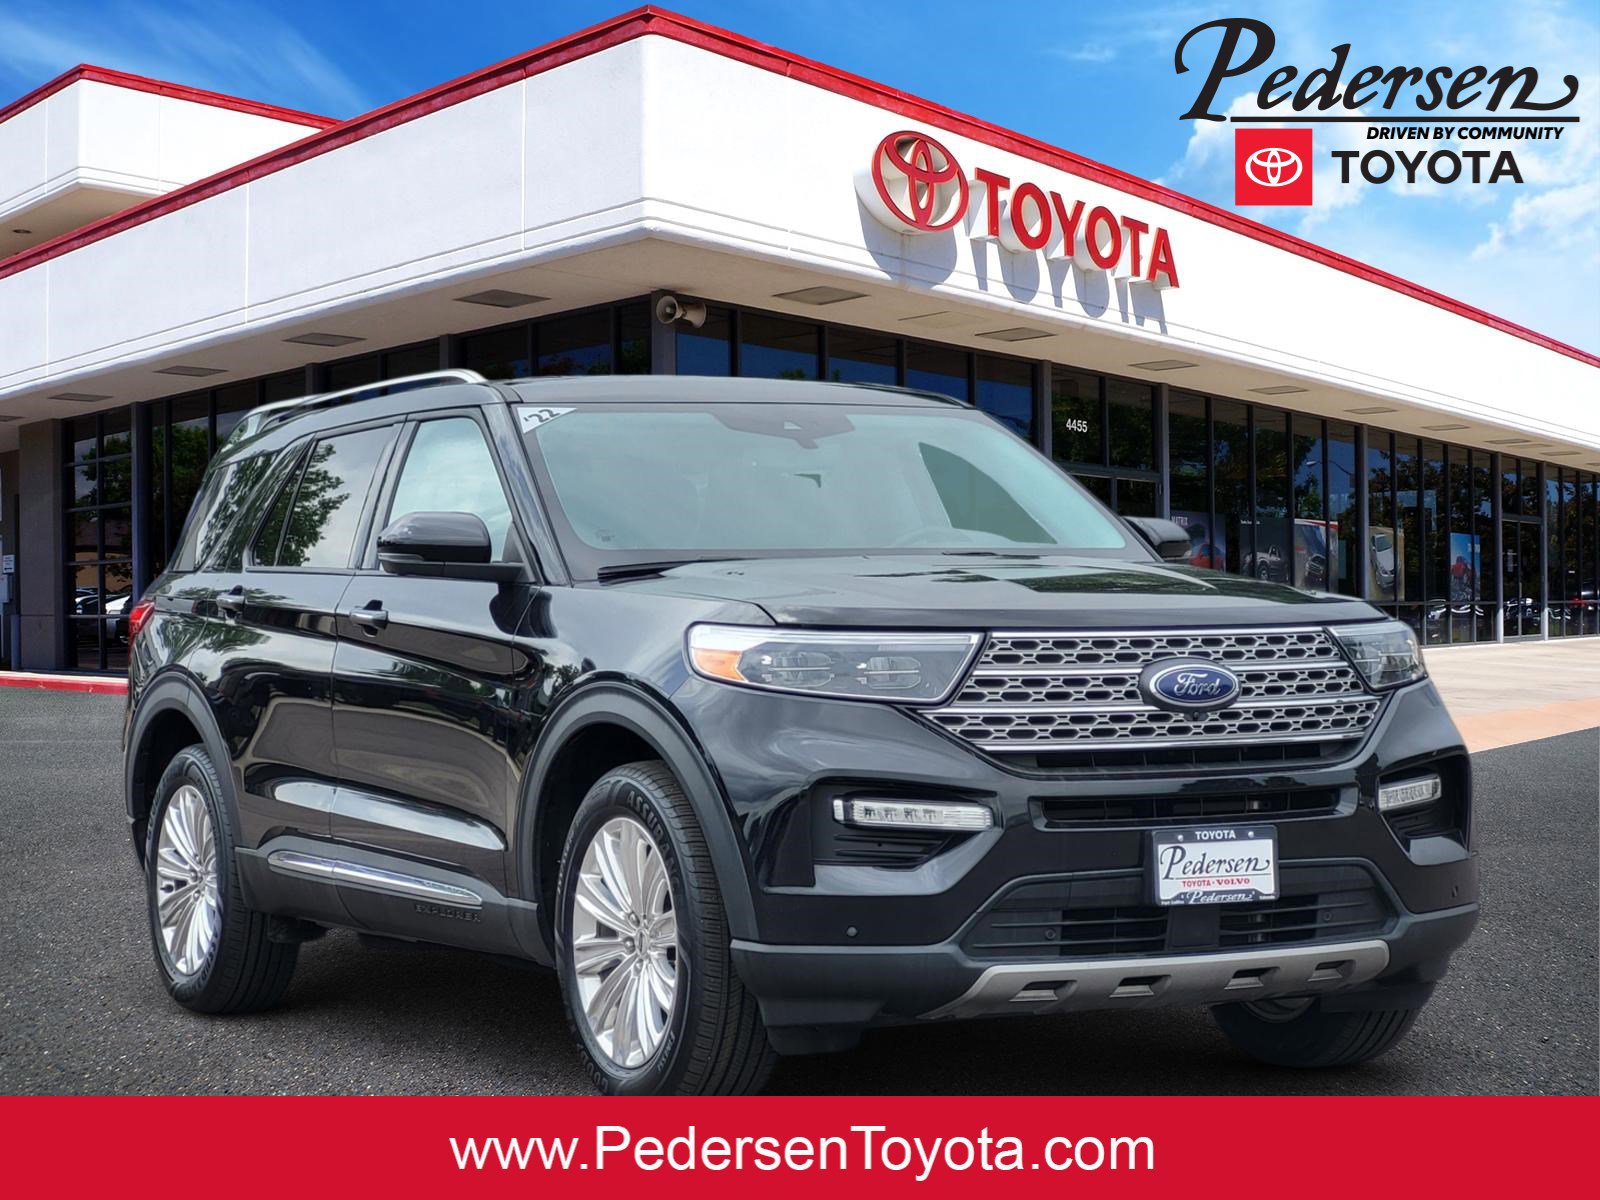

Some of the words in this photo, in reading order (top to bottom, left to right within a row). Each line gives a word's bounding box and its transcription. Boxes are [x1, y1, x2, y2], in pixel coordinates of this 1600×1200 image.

[975, 167, 1180, 288] TOYOTA
[1066, 418, 1088, 433] 4455
[1173, 672, 1222, 697] Ford
[1195, 829, 1237, 841] TOYOTA
[1160, 845, 1271, 880] Pedersen
[1182, 879, 1212, 888] TOYOTA
[1216, 877, 1251, 886] VOLVO
[1186, 889, 1254, 905] Pedersen
